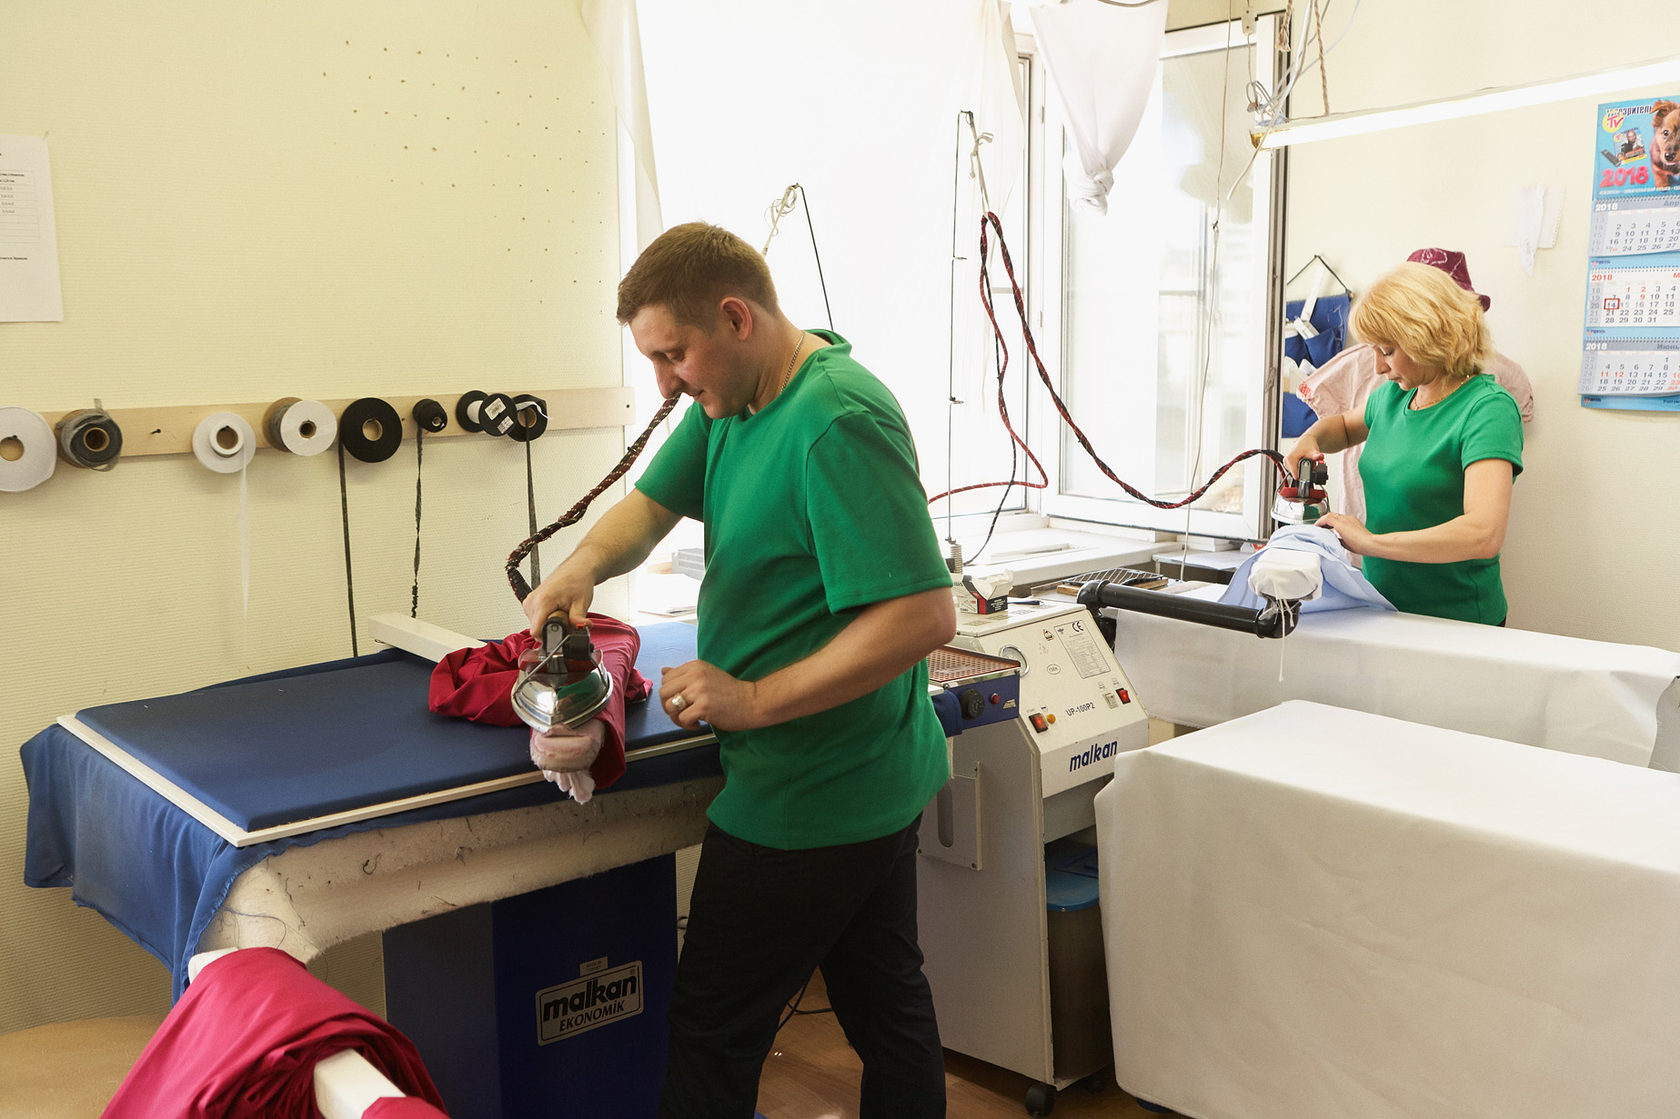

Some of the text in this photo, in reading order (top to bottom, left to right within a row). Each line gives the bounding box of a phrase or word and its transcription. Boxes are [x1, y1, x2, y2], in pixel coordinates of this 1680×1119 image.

[1607, 115, 1624, 128] TV
[1600, 166, 1649, 188] 2018
[1595, 203, 1618, 212] 2018
[1072, 621, 1084, 632] CE
[1065, 701, 1096, 717] UP-100P2
[1069, 741, 1118, 772] malkan
[543, 975, 637, 1022] malkan
[559, 1000, 625, 1032] EKONOMİK
